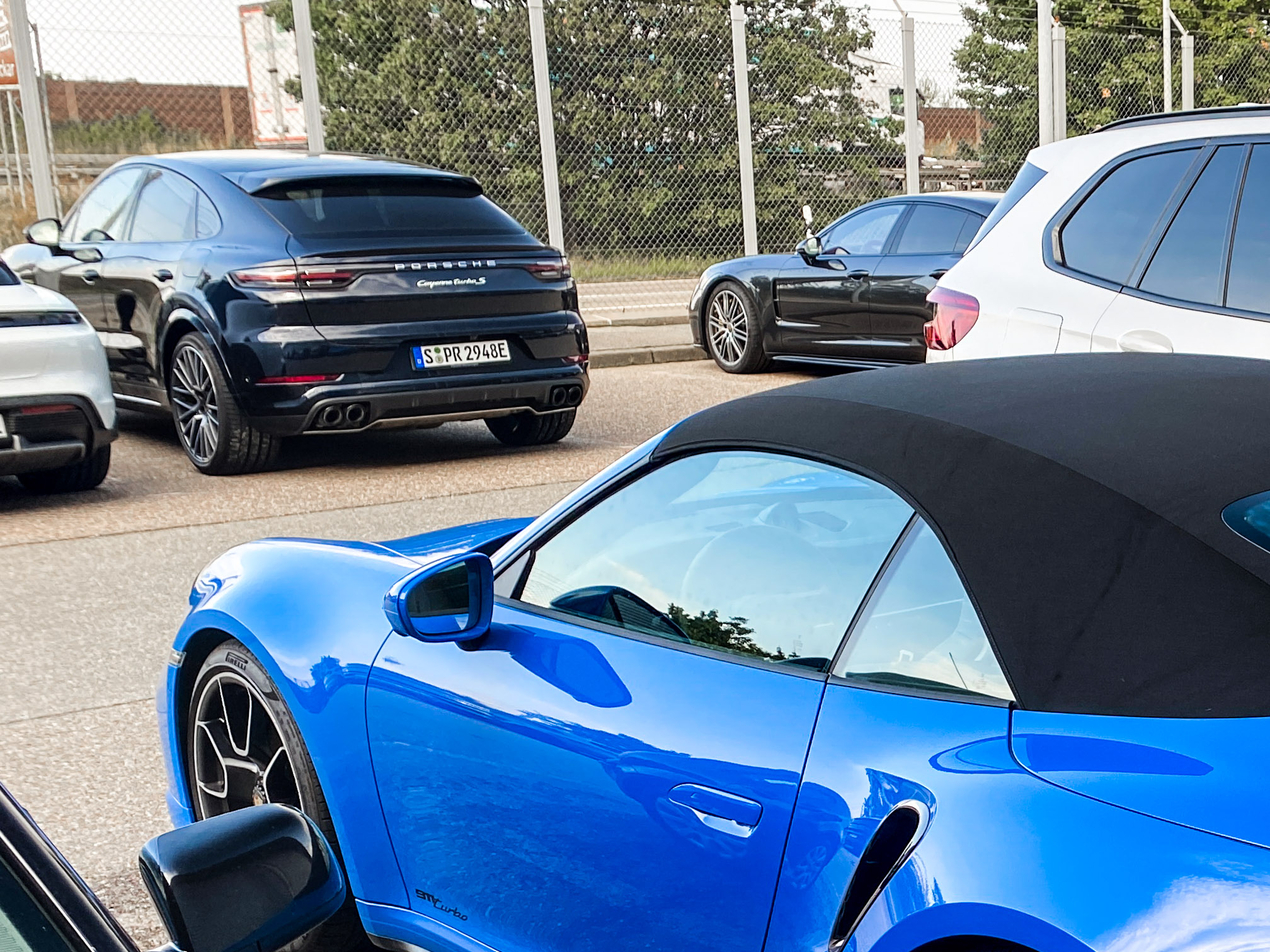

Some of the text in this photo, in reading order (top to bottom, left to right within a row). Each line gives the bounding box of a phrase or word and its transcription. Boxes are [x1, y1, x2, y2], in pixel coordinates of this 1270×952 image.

[395, 260, 497, 271] PORSCHE
[416, 279, 453, 289] Cayenne
[476, 276, 487, 285] S
[424, 348, 434, 364] S
[443, 346, 463, 363] PR
[464, 342, 508, 361] 2948E
[225, 651, 249, 671] PIRELLI
